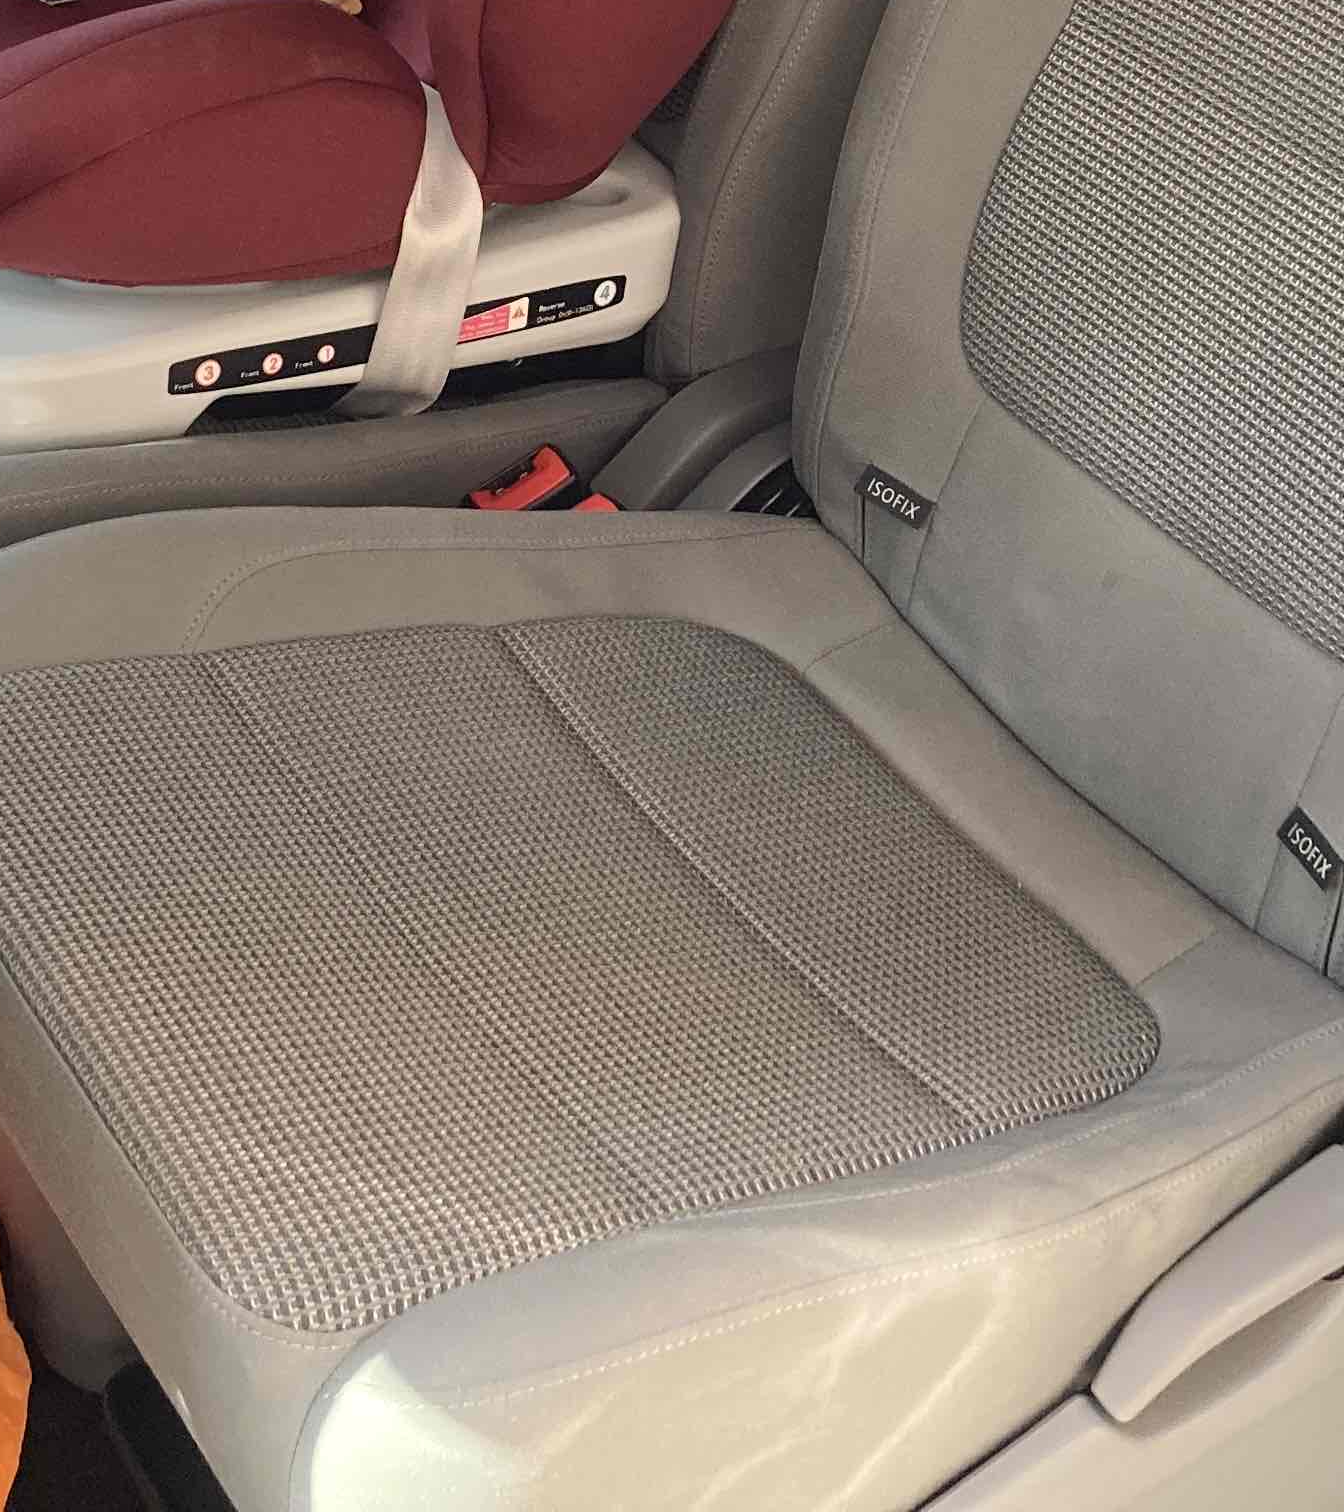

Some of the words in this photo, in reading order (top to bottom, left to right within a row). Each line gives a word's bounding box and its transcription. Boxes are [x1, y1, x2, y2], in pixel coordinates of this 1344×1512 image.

[599, 285, 610, 300] 4
[269, 357, 278, 371] 2
[204, 366, 214, 381] 3
[867, 477, 921, 520] ISOFIX
[1287, 822, 1332, 880] ISOFIX
